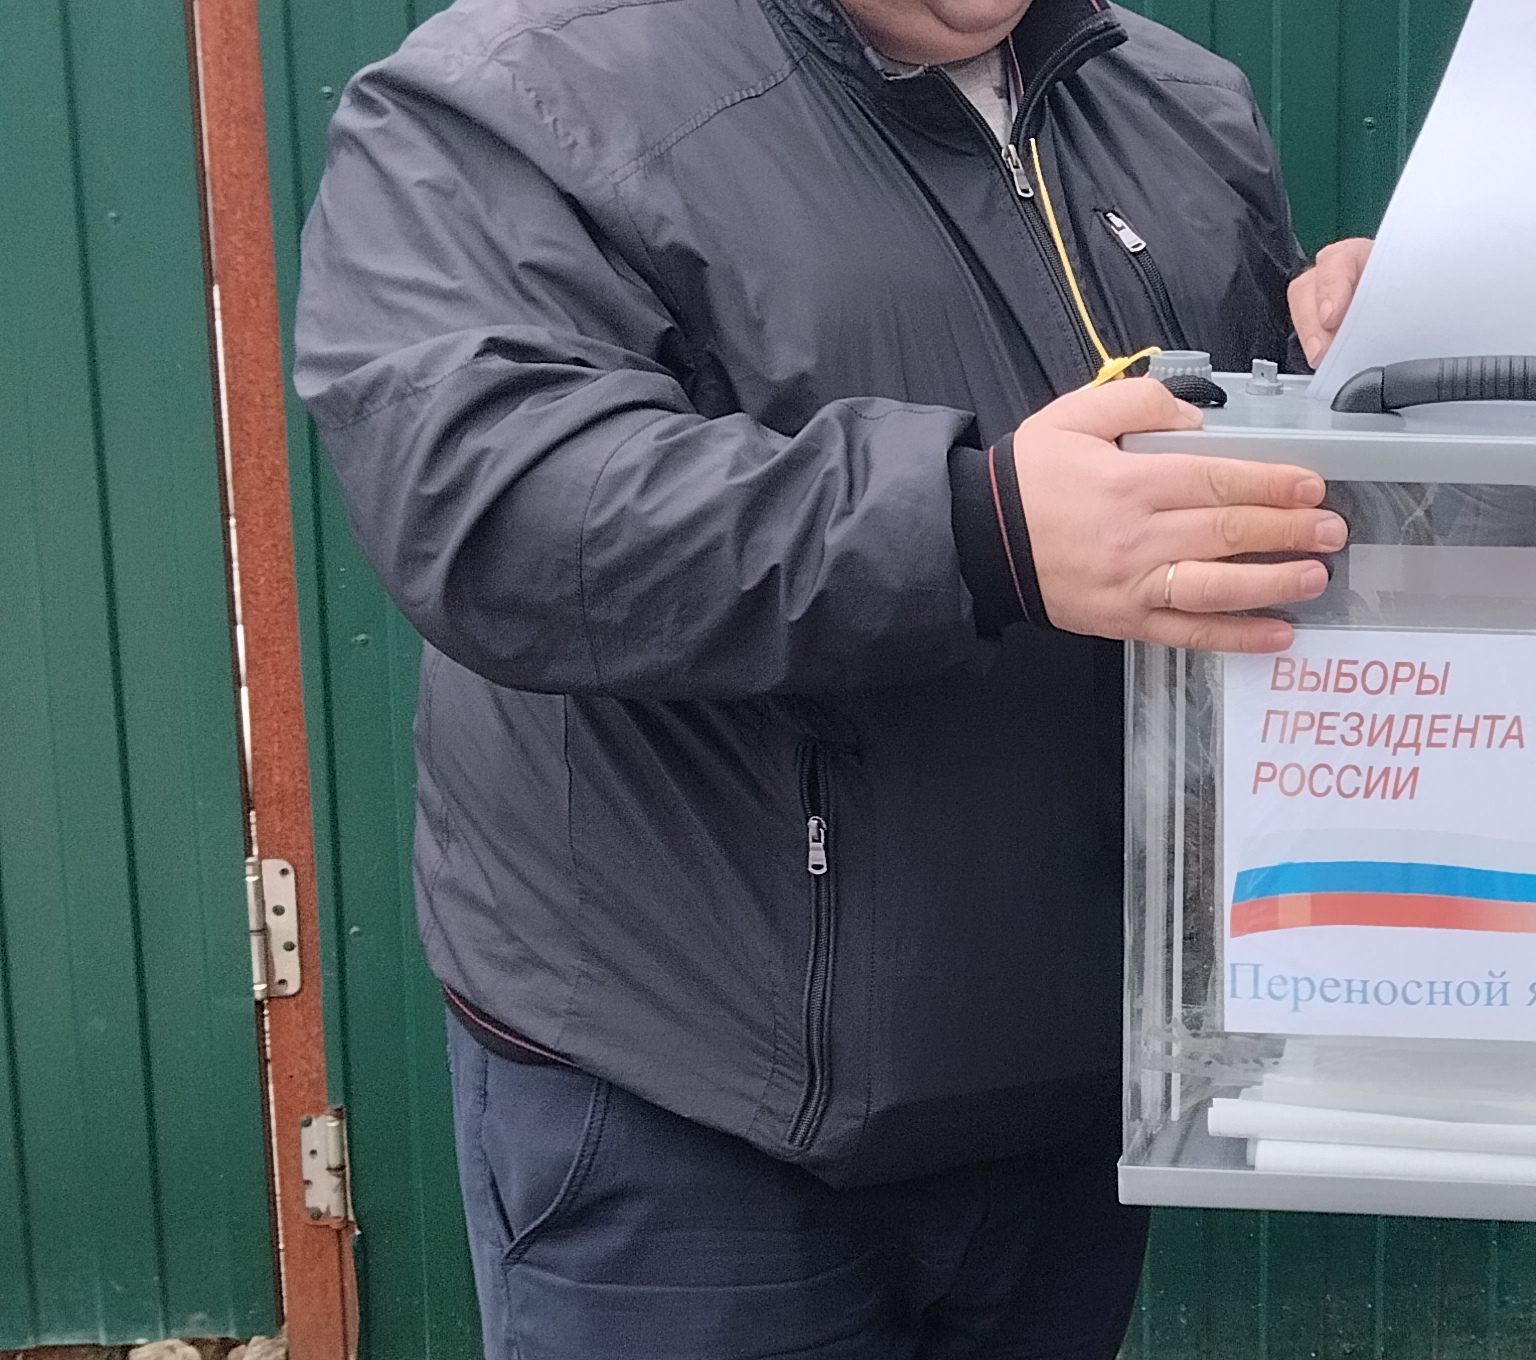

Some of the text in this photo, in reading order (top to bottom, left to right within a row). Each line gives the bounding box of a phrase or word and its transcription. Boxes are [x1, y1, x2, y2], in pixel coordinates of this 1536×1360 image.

[1270, 657, 1451, 696] ВЫБОРЫ
[1260, 709, 1526, 756] ПРЕЗИДЕНТА
[1251, 761, 1420, 801] РОССИИ
[1228, 962, 1510, 1013] Переносной
